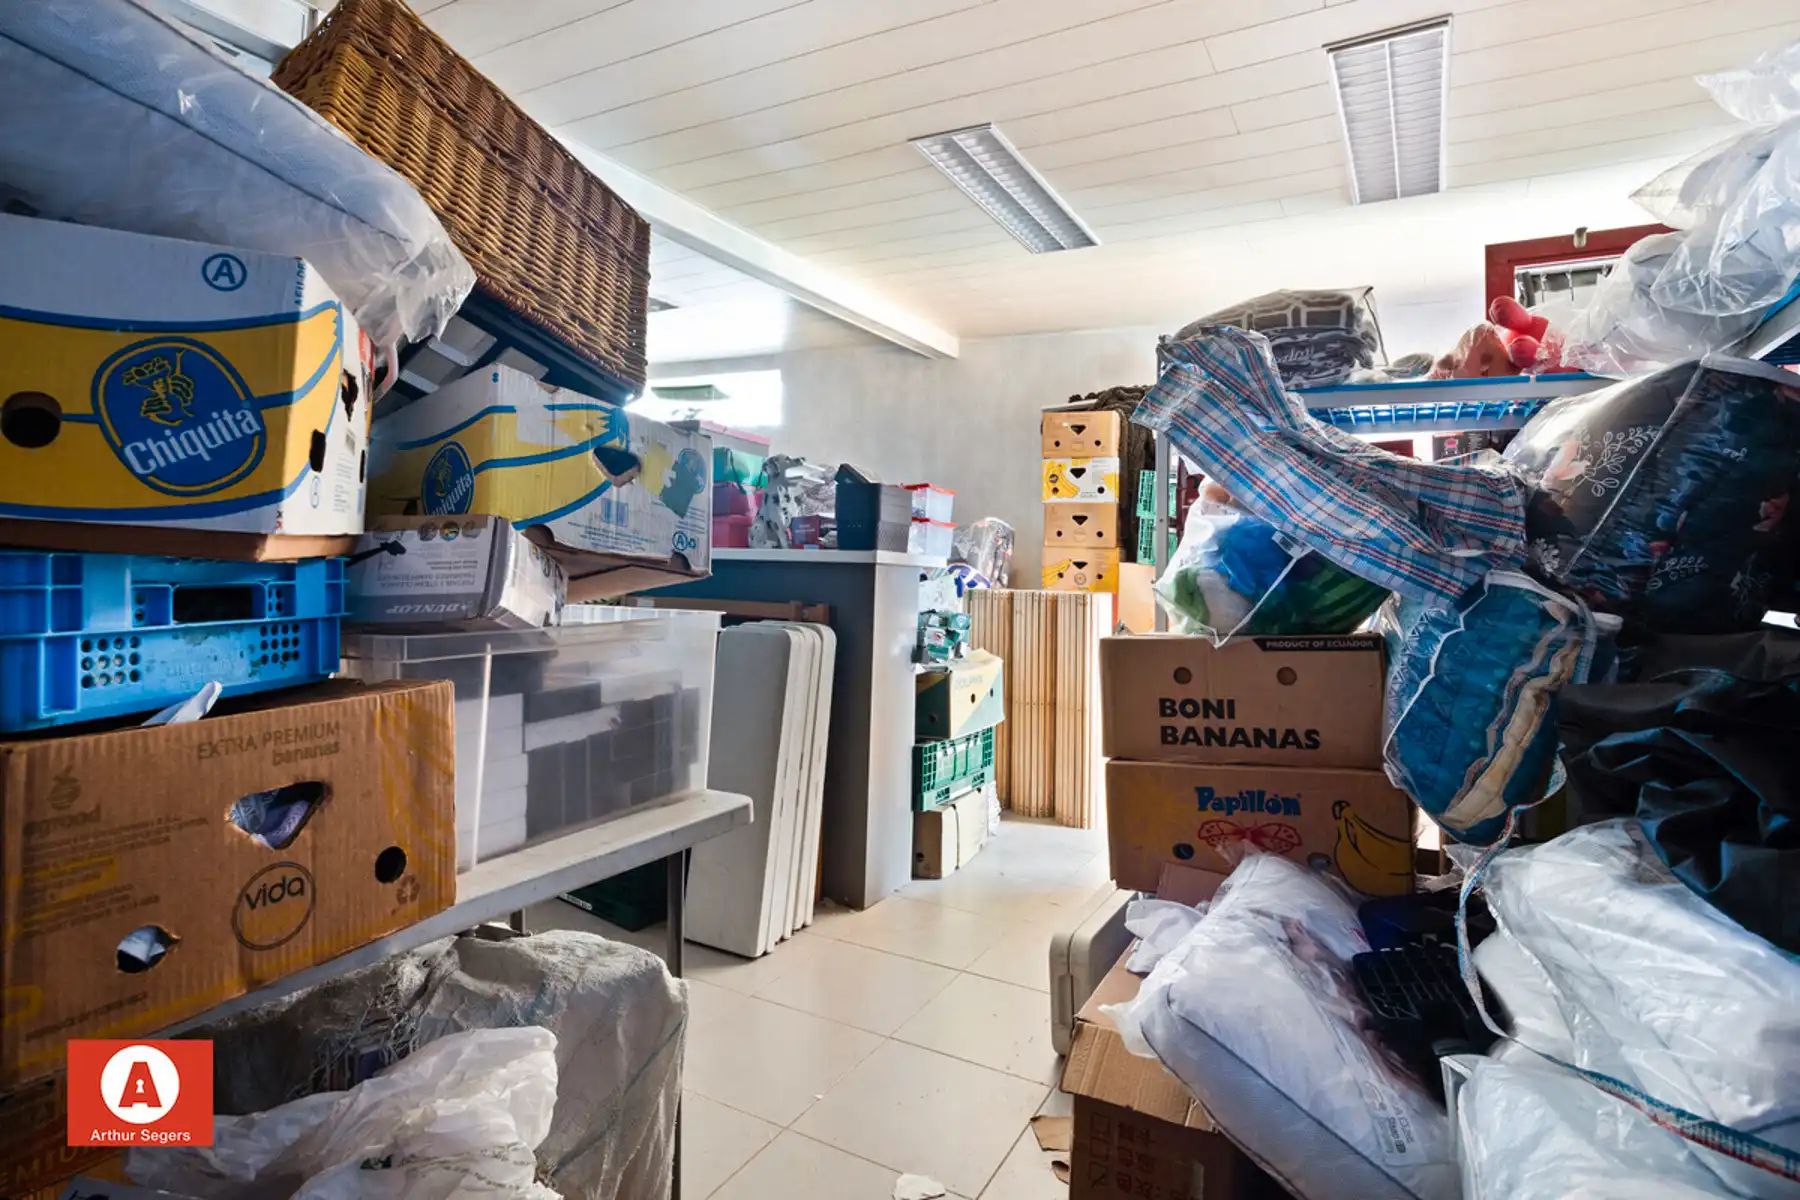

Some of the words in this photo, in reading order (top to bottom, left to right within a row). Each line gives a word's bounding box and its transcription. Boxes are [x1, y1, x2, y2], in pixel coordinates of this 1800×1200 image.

[123, 406, 261, 476] Chiquita
[430, 473, 472, 516] hiquita
[385, 603, 460, 614] DUNLOP
[1266, 640, 1309, 648] PRODUCT
[1312, 640, 1324, 648] OF
[1327, 640, 1373, 648] ECUADOR
[1158, 698, 1235, 719] BONI
[198, 735, 256, 760] EXTRA
[262, 721, 340, 750] PREMIUM
[1160, 725, 1320, 750] BANANAS
[272, 741, 340, 767] bananas
[245, 874, 304, 911] vida
